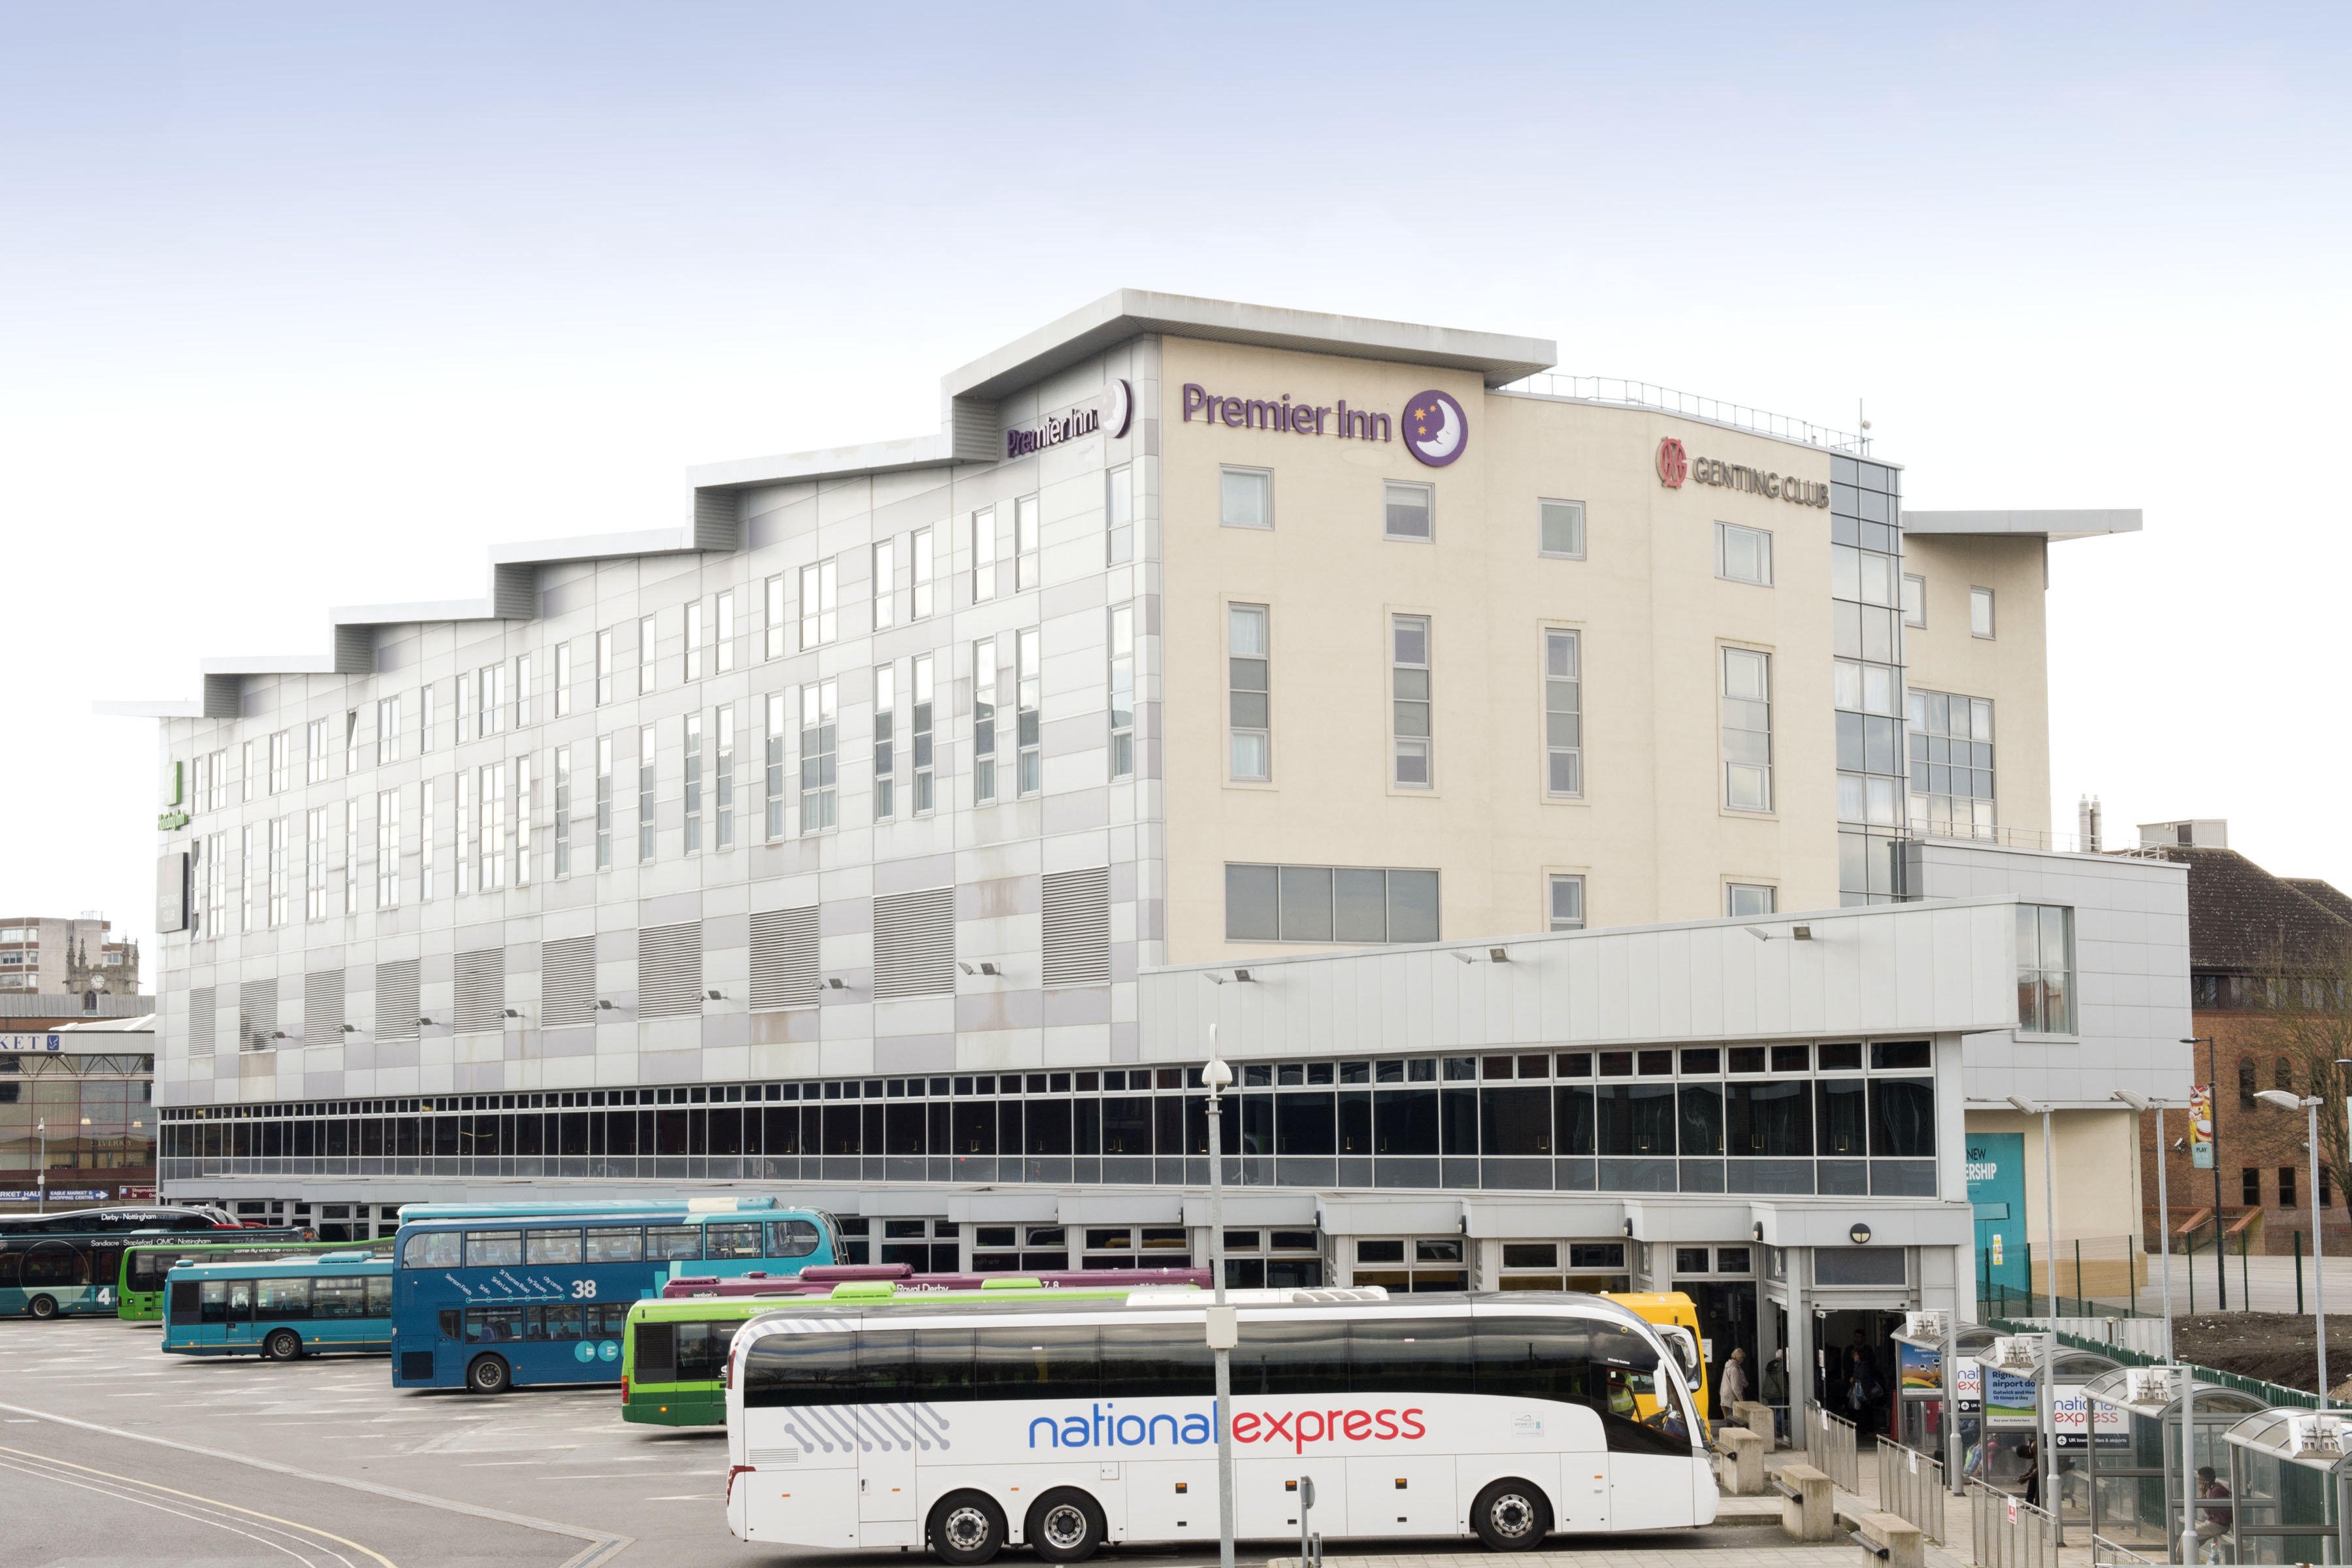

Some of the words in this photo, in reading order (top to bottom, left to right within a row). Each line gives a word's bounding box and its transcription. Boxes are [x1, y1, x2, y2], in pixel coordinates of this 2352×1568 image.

[1183, 383, 1332, 436] Premier
[1338, 399, 1392, 442] Inn
[1007, 416, 1068, 459] Premier
[1068, 408, 1099, 438] Inn
[1692, 457, 1780, 498] GENTING
[1781, 476, 1830, 509] CLUB
[1966, 1147, 1986, 1160] NEW
[101, 1213, 119, 1222] Derby
[122, 1213, 157, 1222] Nottingham
[1773, 1250, 1782, 1278] 24
[444, 1273, 462, 1288] Stenson
[458, 1283, 472, 1296] Fields
[478, 1283, 491, 1295] Sinfin
[502, 1284, 513, 1294] Lane
[505, 1273, 520, 1287] Thomas
[518, 1282, 531, 1294] Road
[531, 1280, 547, 1293] Square
[549, 1281, 564, 1292] centre
[571, 1279, 596, 1299] 38
[1993, 1380, 2023, 1389] airport
[2054, 1396, 2117, 1411] nationa
[1029, 1400, 1219, 1448] national
[1232, 1408, 1426, 1454] express
[2054, 1412, 2119, 1427] expess
